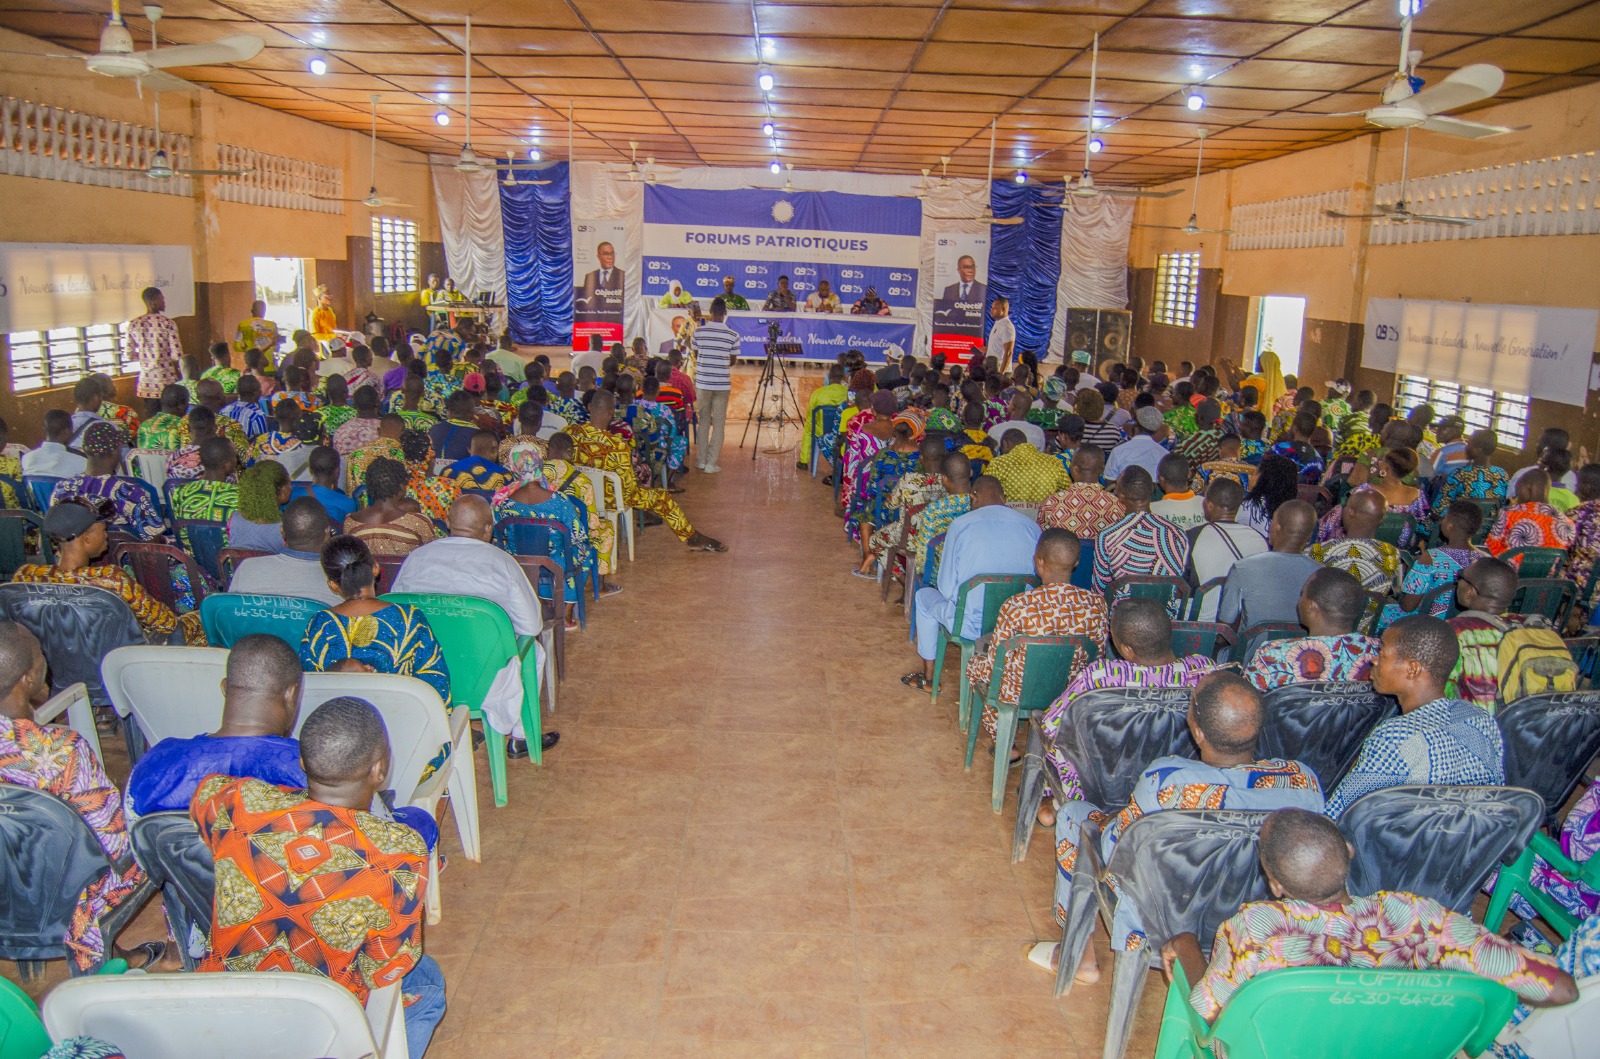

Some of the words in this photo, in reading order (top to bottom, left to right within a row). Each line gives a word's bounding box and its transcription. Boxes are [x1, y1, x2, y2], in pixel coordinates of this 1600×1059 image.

[685, 232, 751, 246] FORUMS
[755, 235, 869, 252] PATRIOTIQUES
[595, 289, 623, 298] Objectif
[954, 302, 983, 311] Objectif
[807, 332, 846, 346] Nouvelle
[1472, 333, 1506, 354] Nouvelle
[1508, 336, 1559, 360] Génération
[234, 608, 306, 620] 66-30-64-02
[1329, 990, 1456, 1007] 66-30-64-02
